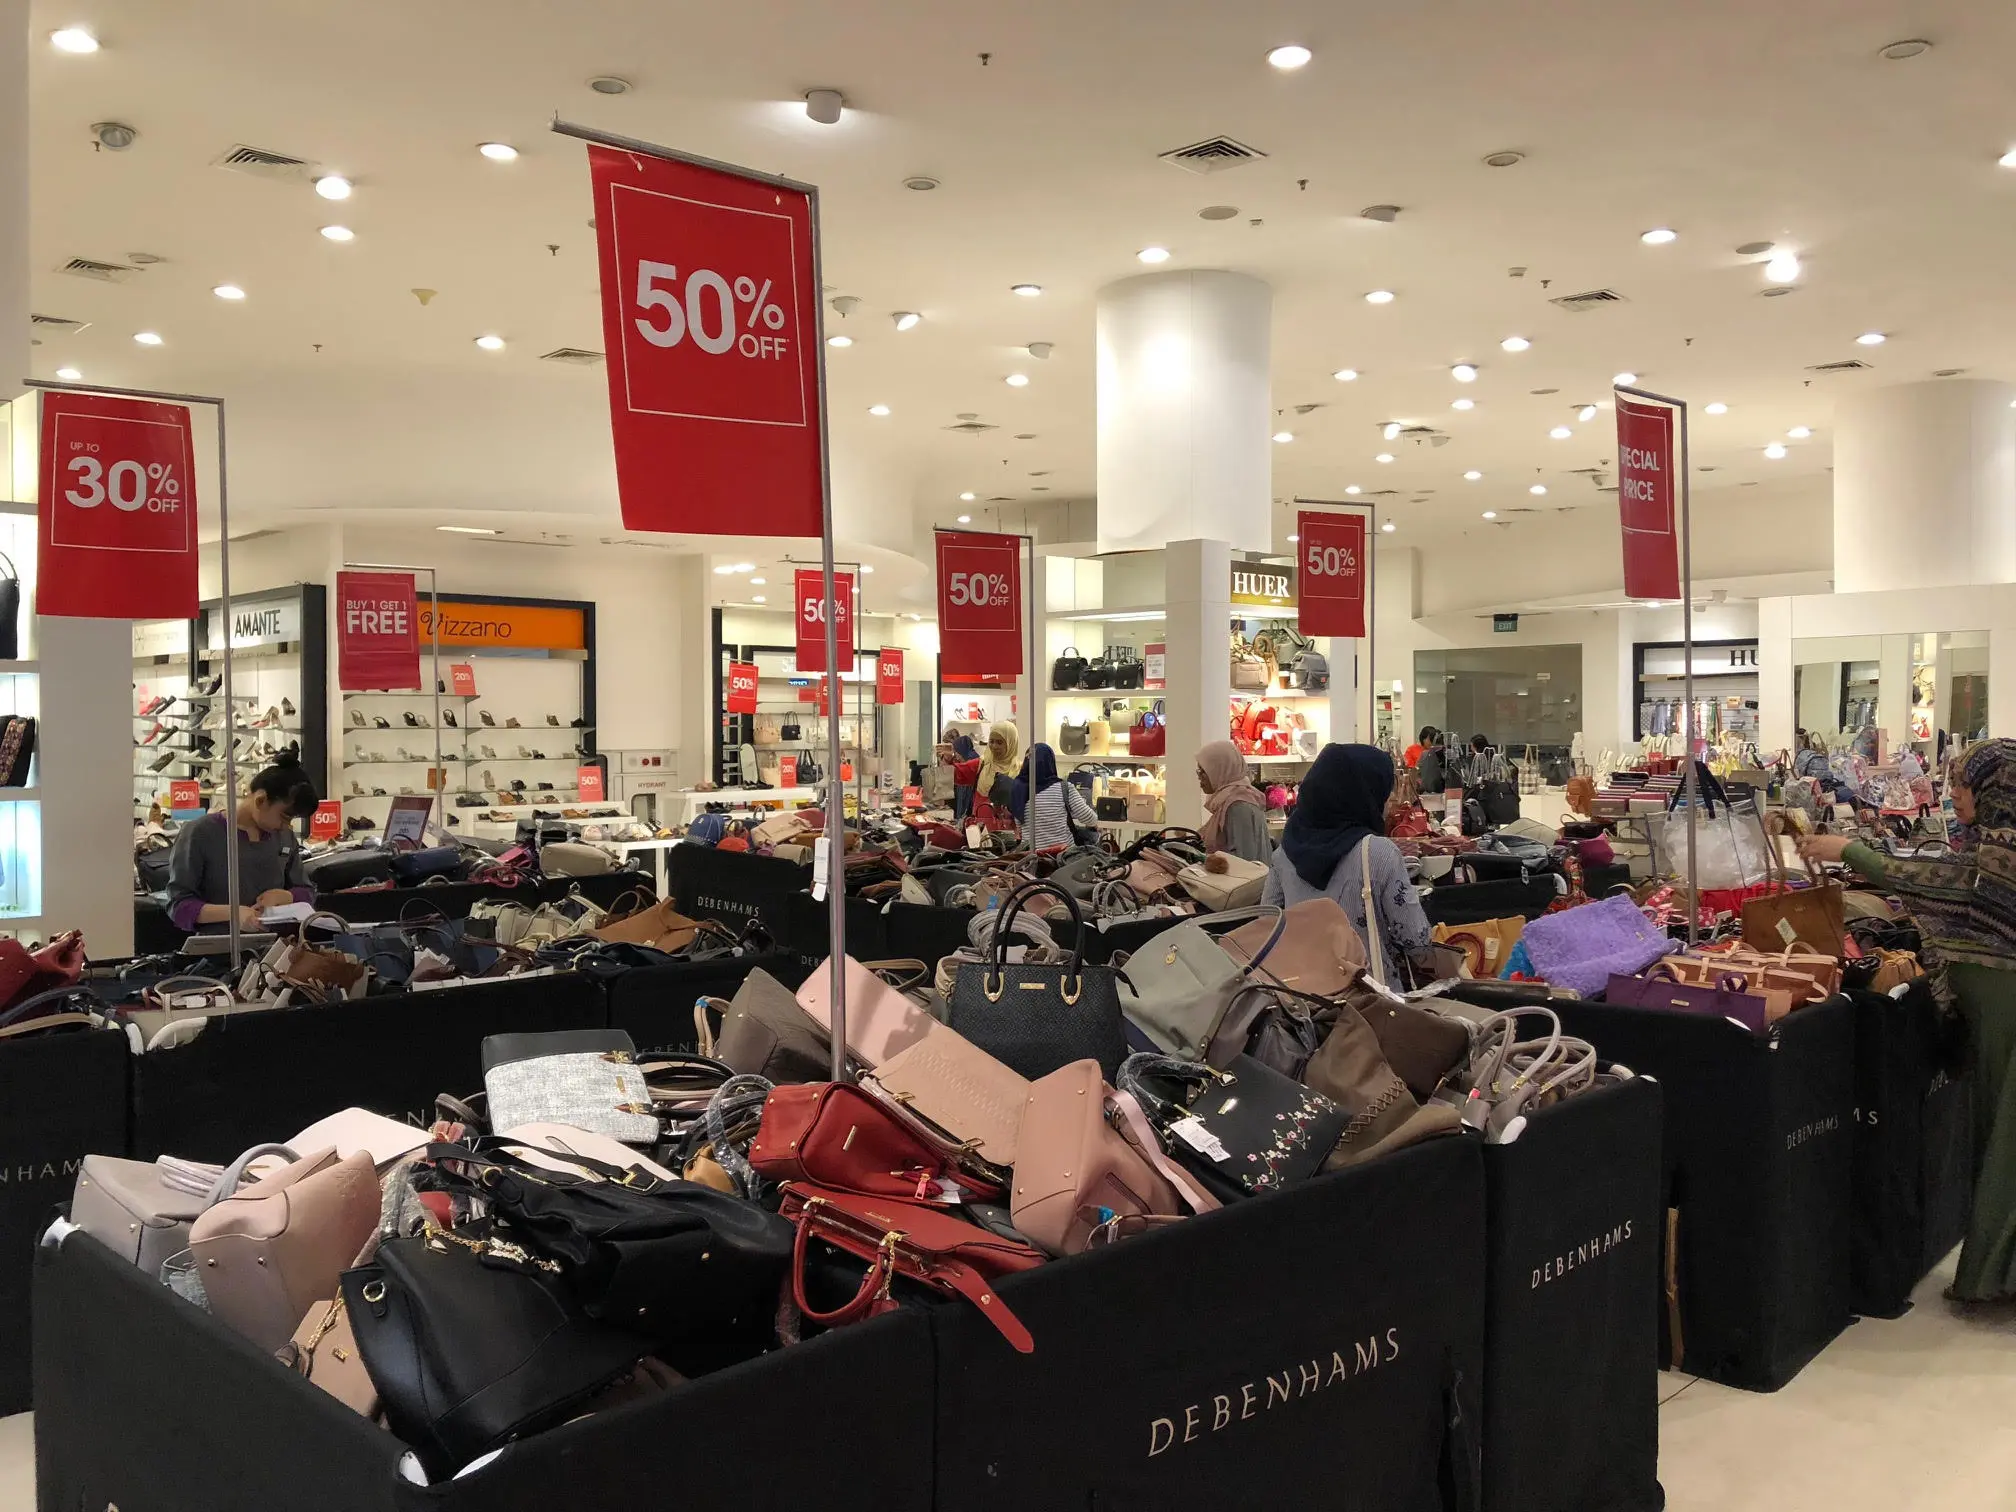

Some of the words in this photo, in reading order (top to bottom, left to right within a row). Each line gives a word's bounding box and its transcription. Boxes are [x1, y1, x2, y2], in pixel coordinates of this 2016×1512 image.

[634, 258, 786, 355] 50%
[70, 441, 83, 451] UP
[86, 442, 100, 453] TO
[65, 456, 180, 512] 30%
[147, 498, 181, 513] OFF
[1308, 546, 1356, 576] 50%
[1339, 568, 1356, 577] OFF
[949, 572, 1009, 606] 50%
[1232, 571, 1291, 598] HUER
[346, 600, 368, 610] BUY
[371, 600, 376, 610] 1
[379, 600, 399, 610] GET
[989, 596, 1010, 606] OFF
[234, 608, 281, 638] AMANTE
[346, 611, 408, 635] FREE
[420, 611, 512, 638] Vizzano
[697, 896, 760, 917] DEBENHAMS
[1531, 1220, 1632, 1289] DEBENHAMS
[1148, 1327, 1400, 1457] DEBENHAMS
